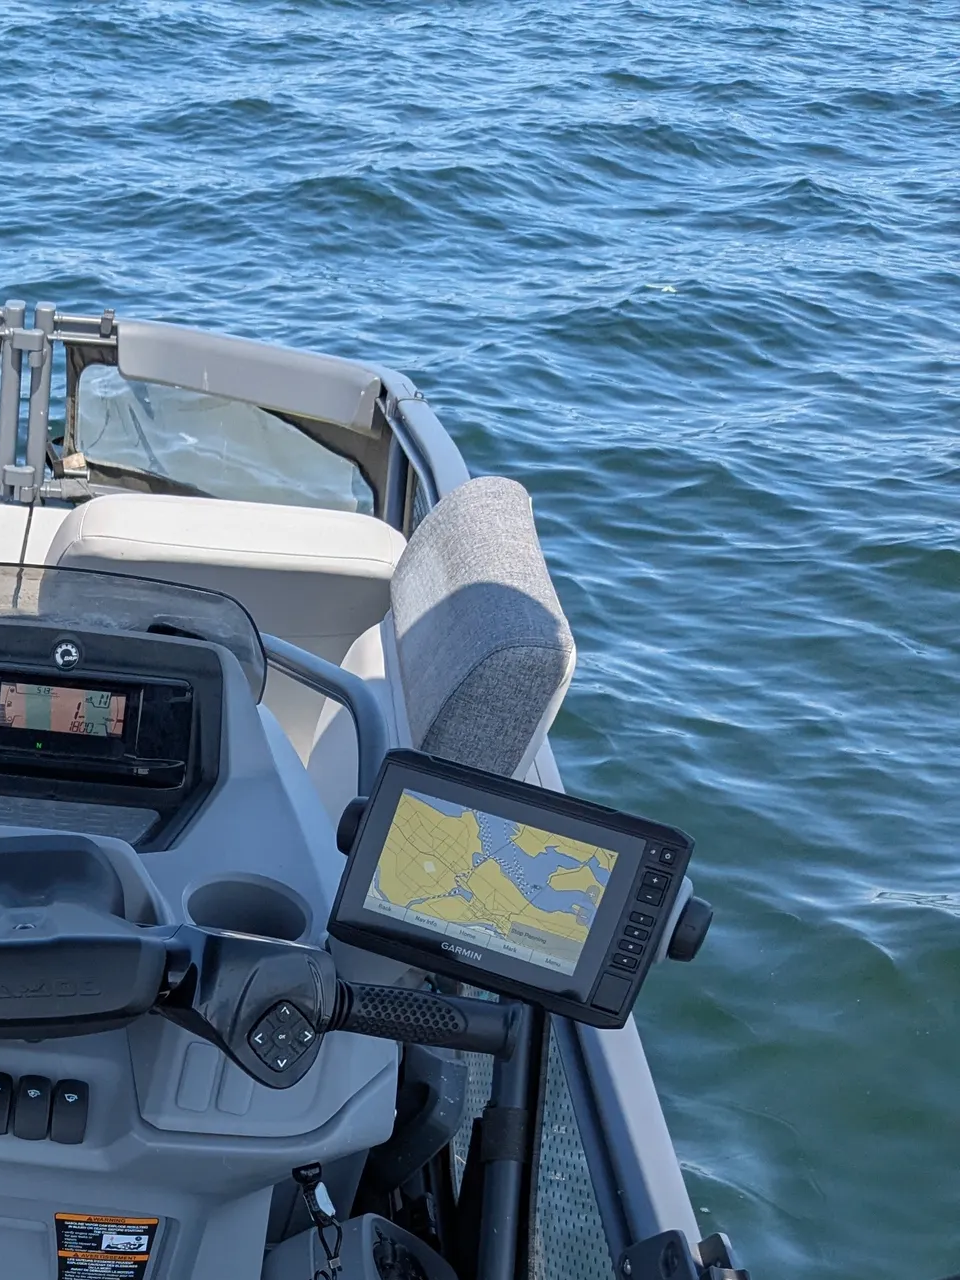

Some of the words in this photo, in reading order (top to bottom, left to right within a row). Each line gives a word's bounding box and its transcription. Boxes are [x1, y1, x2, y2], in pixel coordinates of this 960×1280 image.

[69, 721, 94, 734] 1800
[459, 929, 476, 940] Home
[441, 941, 483, 961] GARMIN
[502, 943, 518, 954] Mark
[545, 957, 561, 968] Menu
